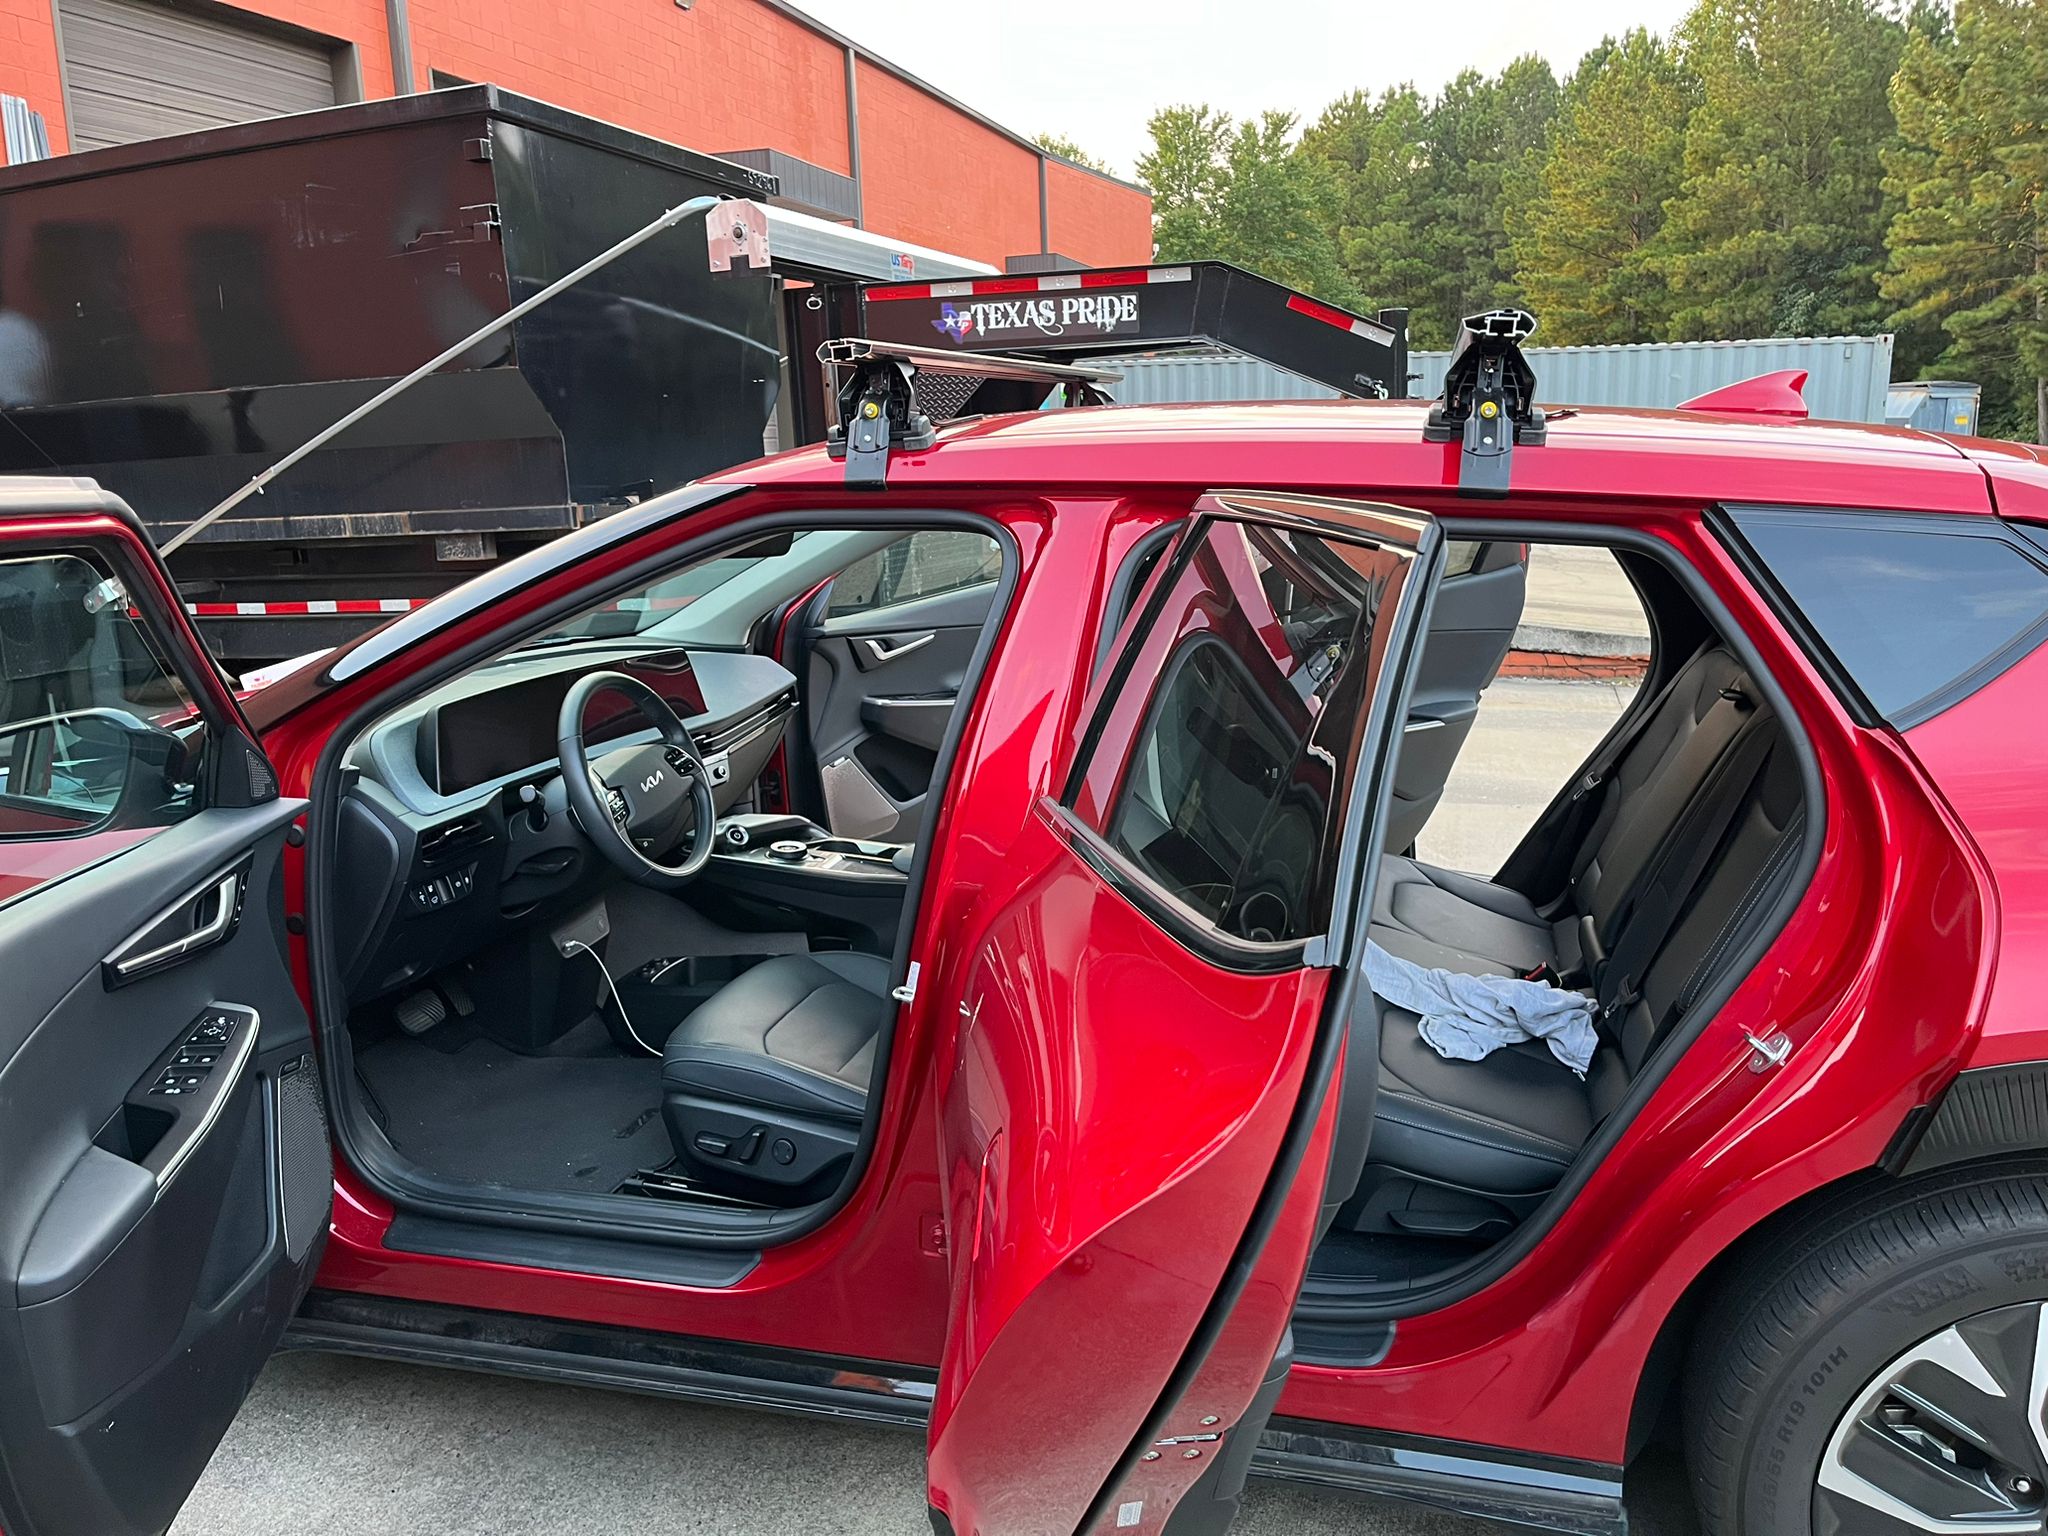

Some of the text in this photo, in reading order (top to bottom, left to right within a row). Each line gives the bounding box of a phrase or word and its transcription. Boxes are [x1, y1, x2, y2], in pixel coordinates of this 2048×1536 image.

[970, 294, 1138, 336] TEXAS PRIDE
[1776, 1400, 1805, 1443] R19
[1802, 1345, 1849, 1397] 101H
